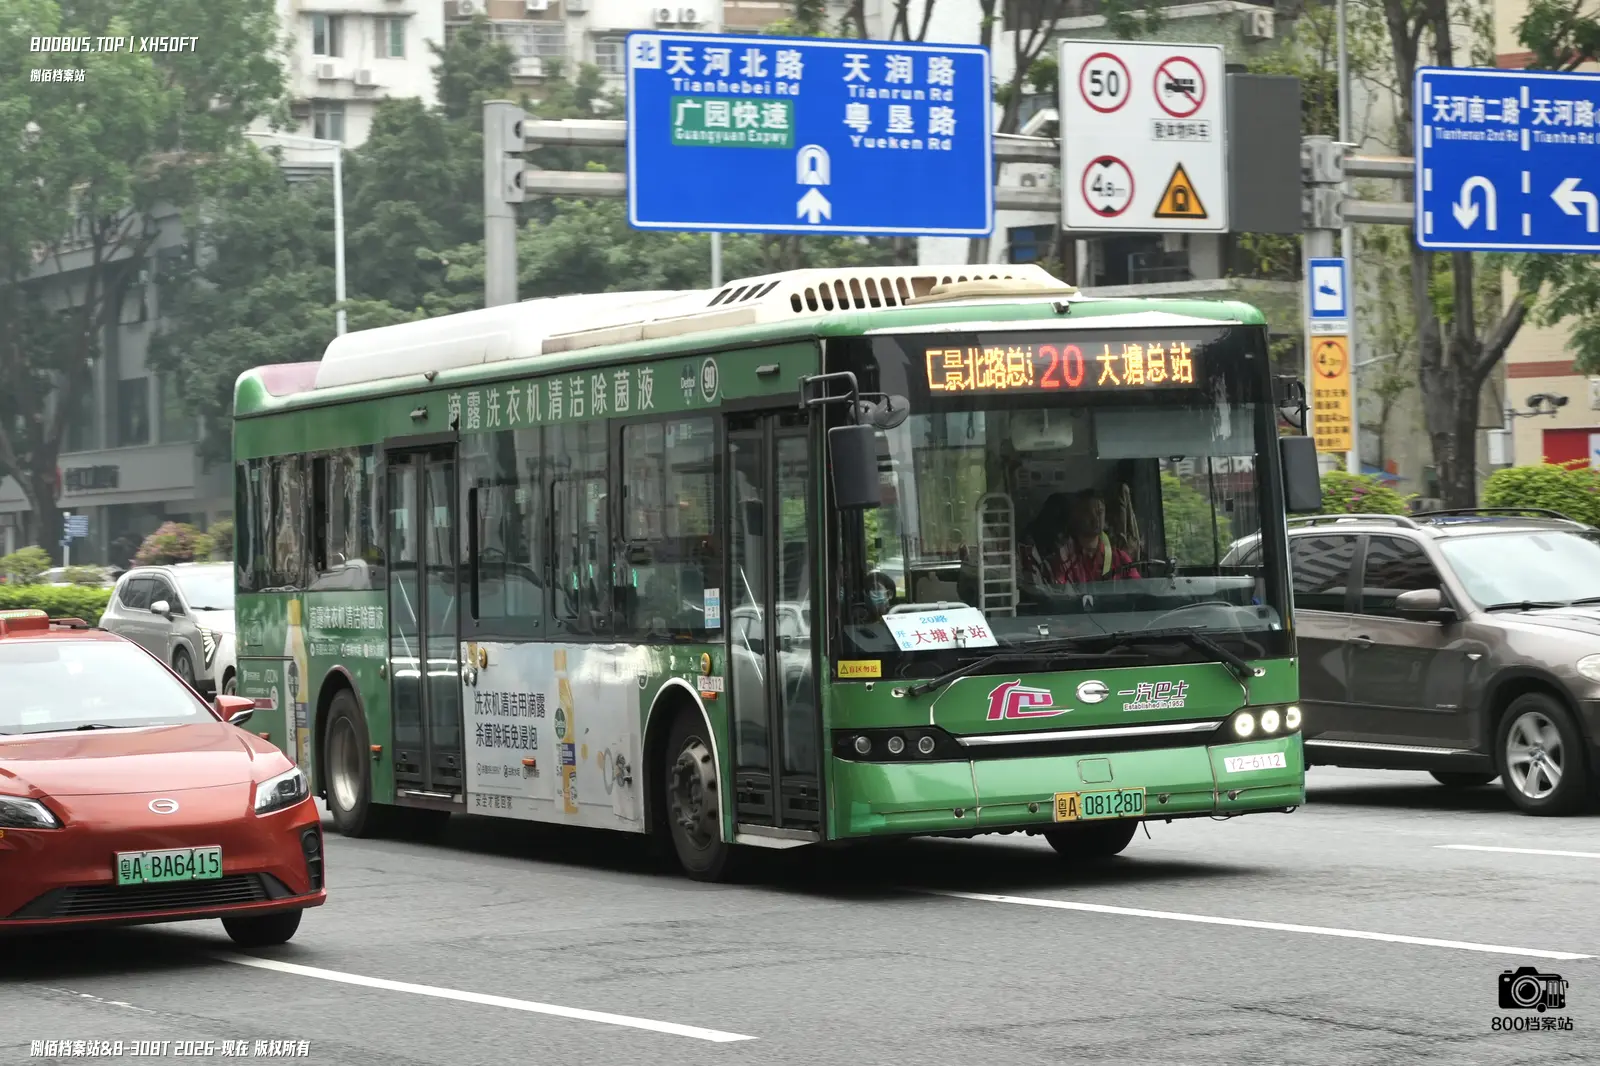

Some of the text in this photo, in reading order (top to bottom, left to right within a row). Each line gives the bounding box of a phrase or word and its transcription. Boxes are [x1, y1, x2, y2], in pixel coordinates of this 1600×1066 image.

[635, 41, 656, 62] 北
[666, 46, 805, 80] 天河北路
[842, 53, 956, 86] 天润路
[671, 77, 800, 96] Tianhebei Rd
[847, 84, 954, 102] Tianrun Rd
[1090, 70, 1120, 97] 50
[674, 100, 790, 130] 广园快速
[843, 102, 957, 136] 粤垦路
[1432, 95, 1521, 125] 天河南二路
[674, 127, 746, 144] Guangyuan
[849, 134, 953, 151] Yueken Rd
[1533, 130, 1576, 144] Tianhe
[1578, 132, 1594, 144] Rd
[1038, 344, 1084, 388] 20
[1096, 341, 1193, 386] 大塘总站
[447, 367, 655, 431] 滴露洗衣机清洁除菌液
[919, 615, 948, 625] 20路
[474, 691, 546, 718] 洗衣机清洁用滴露
[1117, 680, 1190, 703] 一汽巴士
[1123, 702, 1160, 711] Established
[475, 722, 539, 750] 杀菌除垢免浸泡
[1228, 754, 1281, 771] Y2-6112
[1057, 792, 1142, 818] 粤A 08128D
[120, 852, 219, 880] 粤A BA6415
